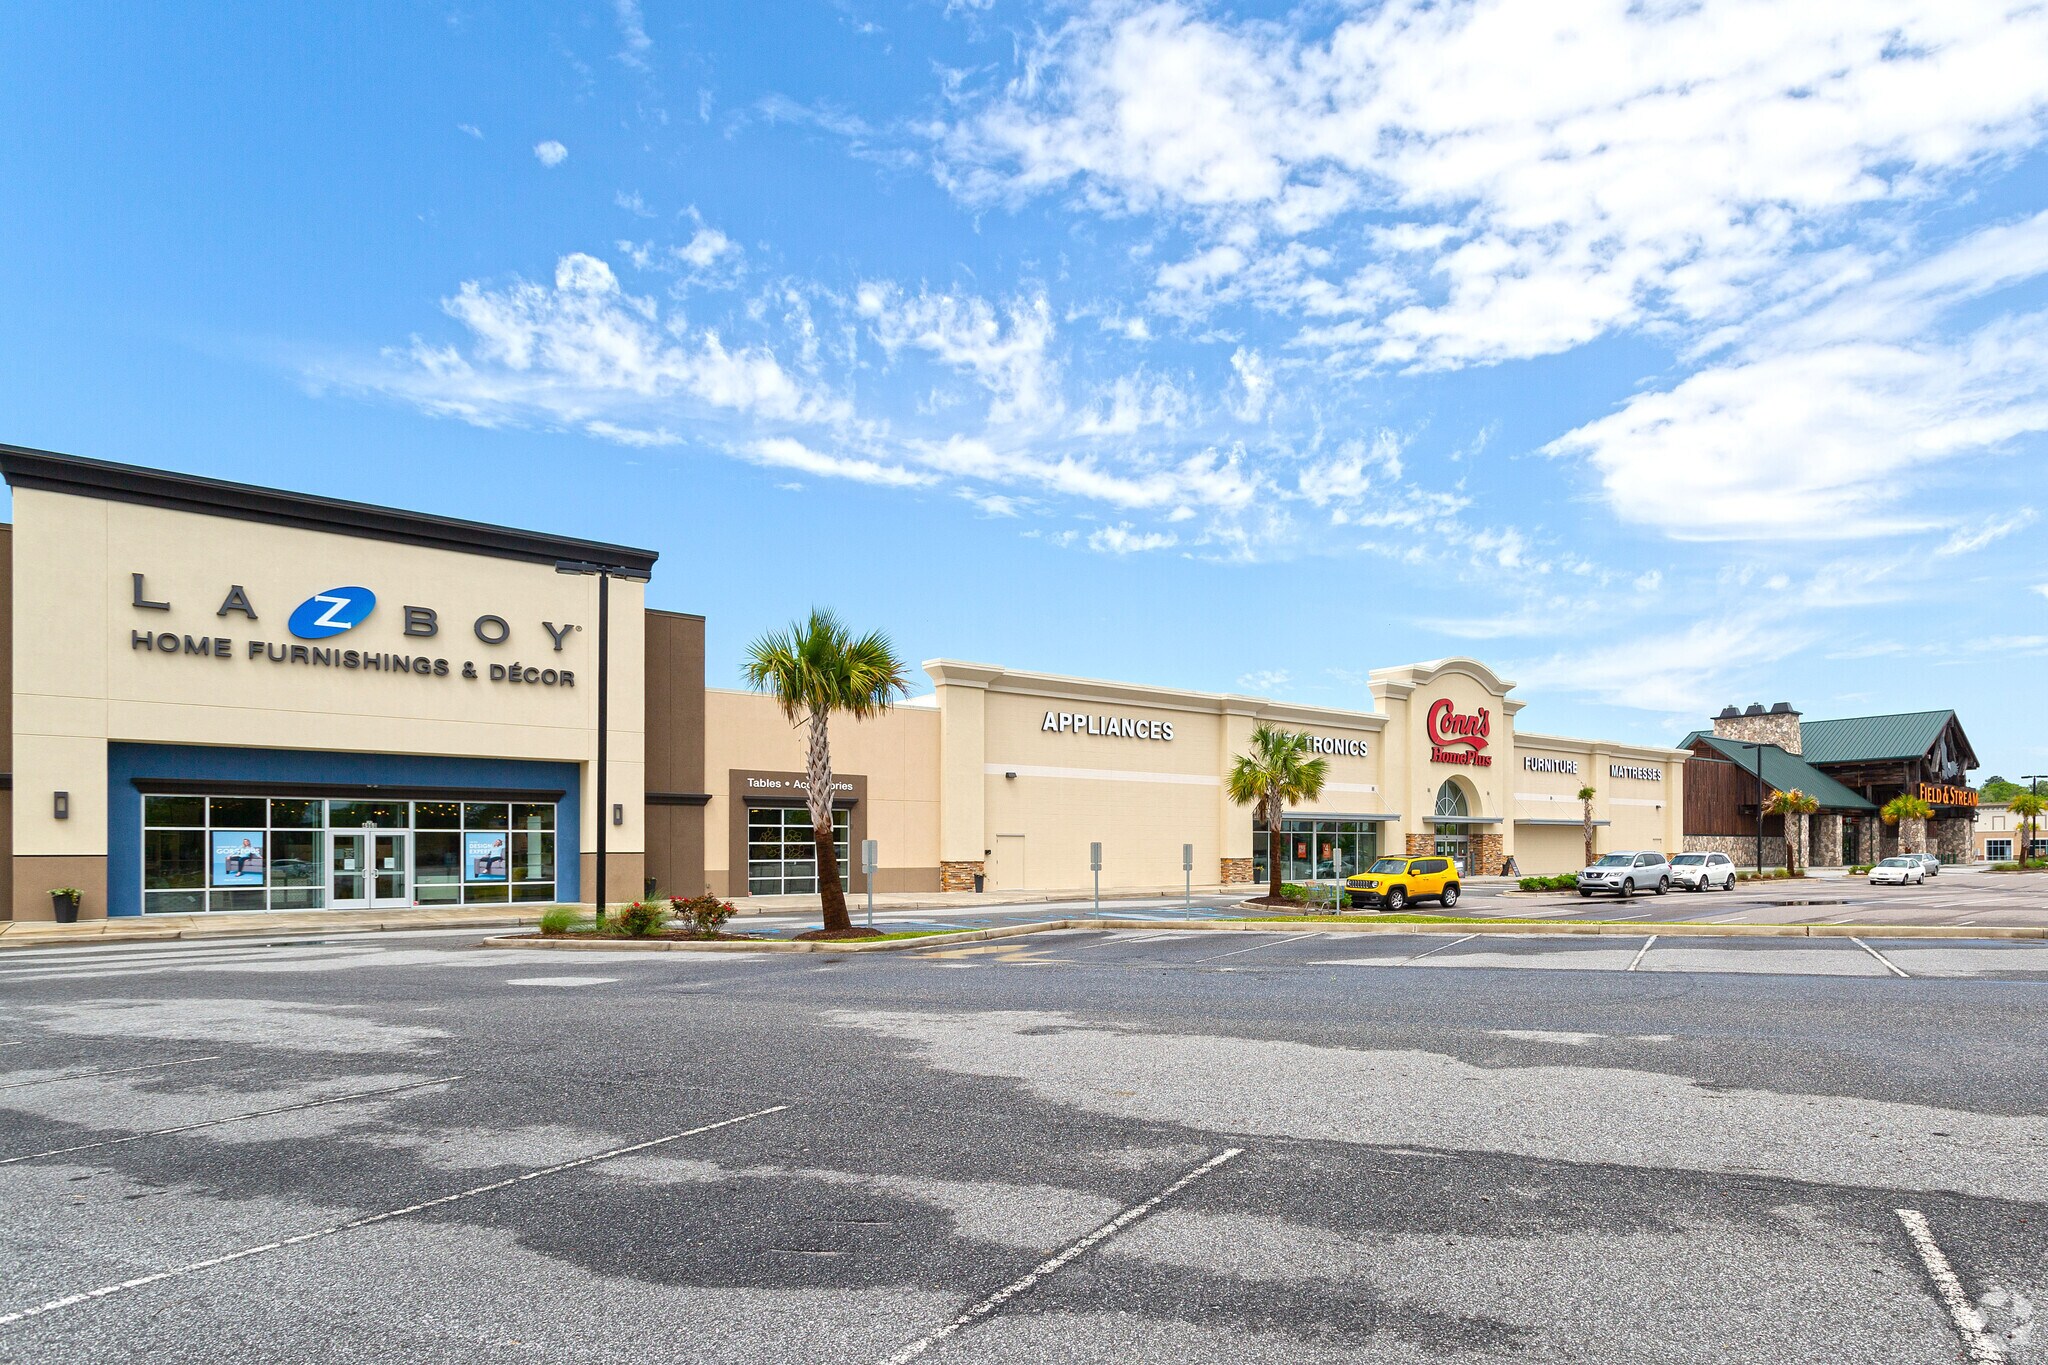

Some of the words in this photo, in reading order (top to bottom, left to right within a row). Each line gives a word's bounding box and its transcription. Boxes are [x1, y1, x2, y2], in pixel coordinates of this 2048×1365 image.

[314, 594, 352, 630] Z
[132, 630, 232, 658] HOME
[248, 640, 450, 677] FURNISHINGS
[461, 661, 478, 680] &
[490, 661, 575, 687] DÉCOR
[1042, 711, 1174, 741] APPLIANCES
[1427, 698, 1490, 751] Conn's
[1524, 757, 1578, 774] FURNITURE
[1610, 765, 1662, 781] MATTRESSES
[747, 778, 782, 788] Tables
[793, 779, 853, 791] Accories
[1920, 782, 1942, 804] FIELD
[1943, 785, 1950, 804] &
[1950, 786, 1979, 807] STREAM
